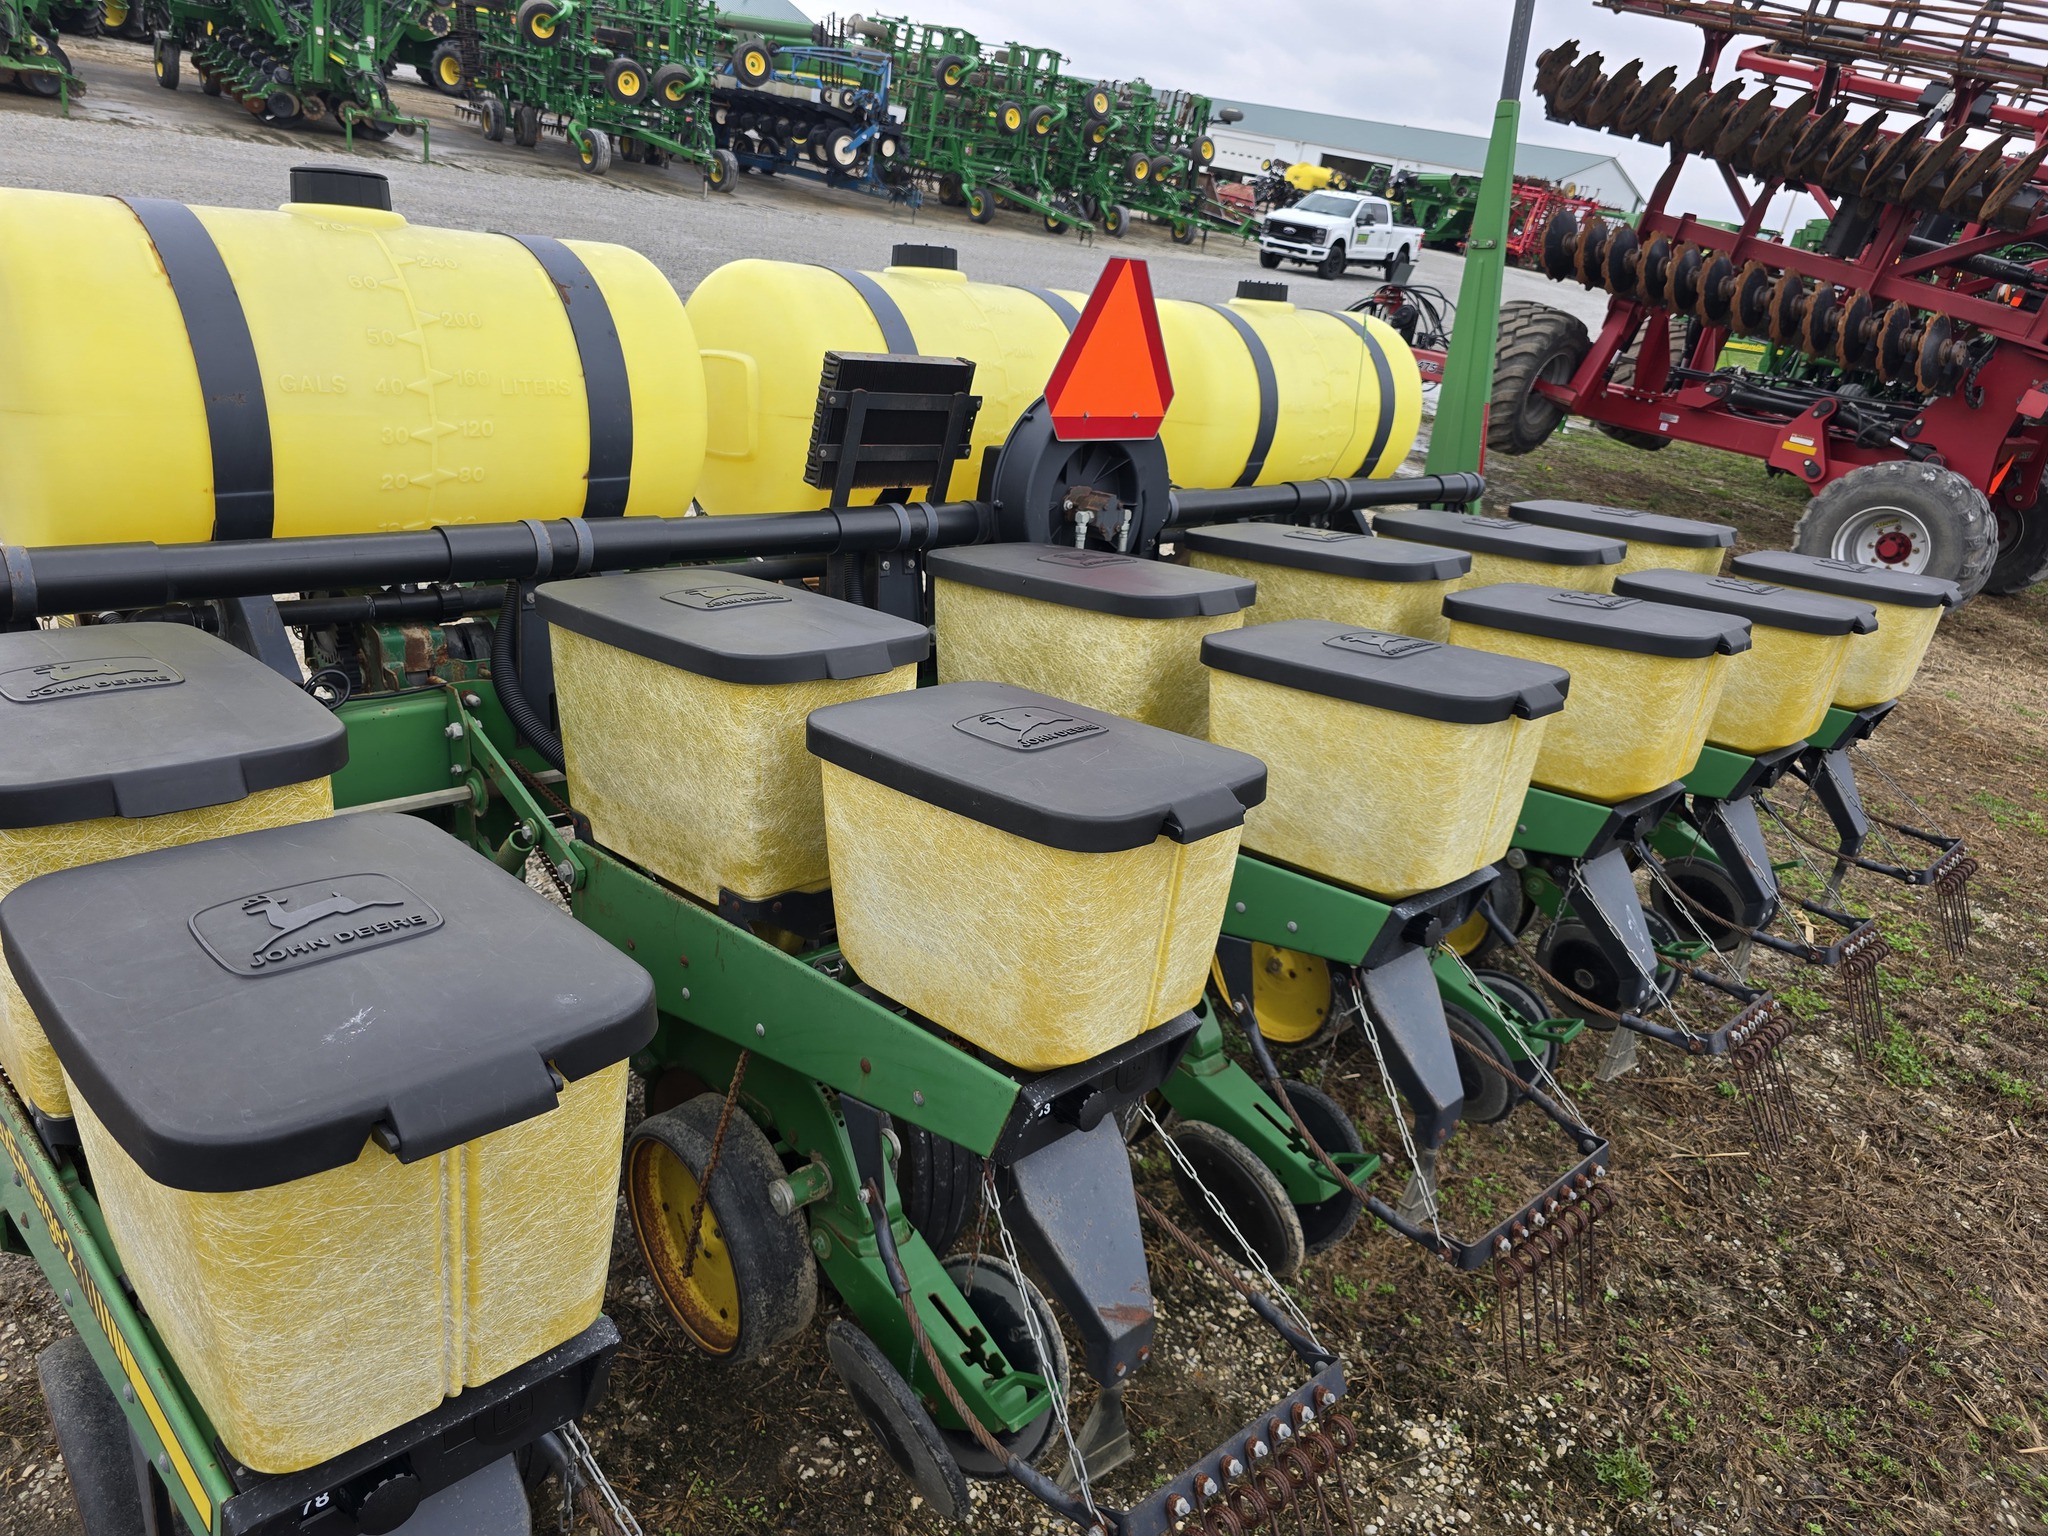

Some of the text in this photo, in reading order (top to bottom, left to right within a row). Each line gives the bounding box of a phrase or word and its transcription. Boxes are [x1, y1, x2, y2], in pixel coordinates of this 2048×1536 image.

[416, 255, 458, 270] 240
[348, 275, 378, 290] 60
[441, 311, 483, 328] 200
[367, 328, 396, 345] 50
[279, 369, 573, 396] GALS 40 160 LITERS
[381, 427, 410, 445] 30
[459, 420, 495, 437] 120
[381, 474, 410, 490] 20
[459, 467, 485, 482] 80
[27, 675, 171, 698] JOHN DEERE
[251, 914, 428, 967] JOHN DEERE
